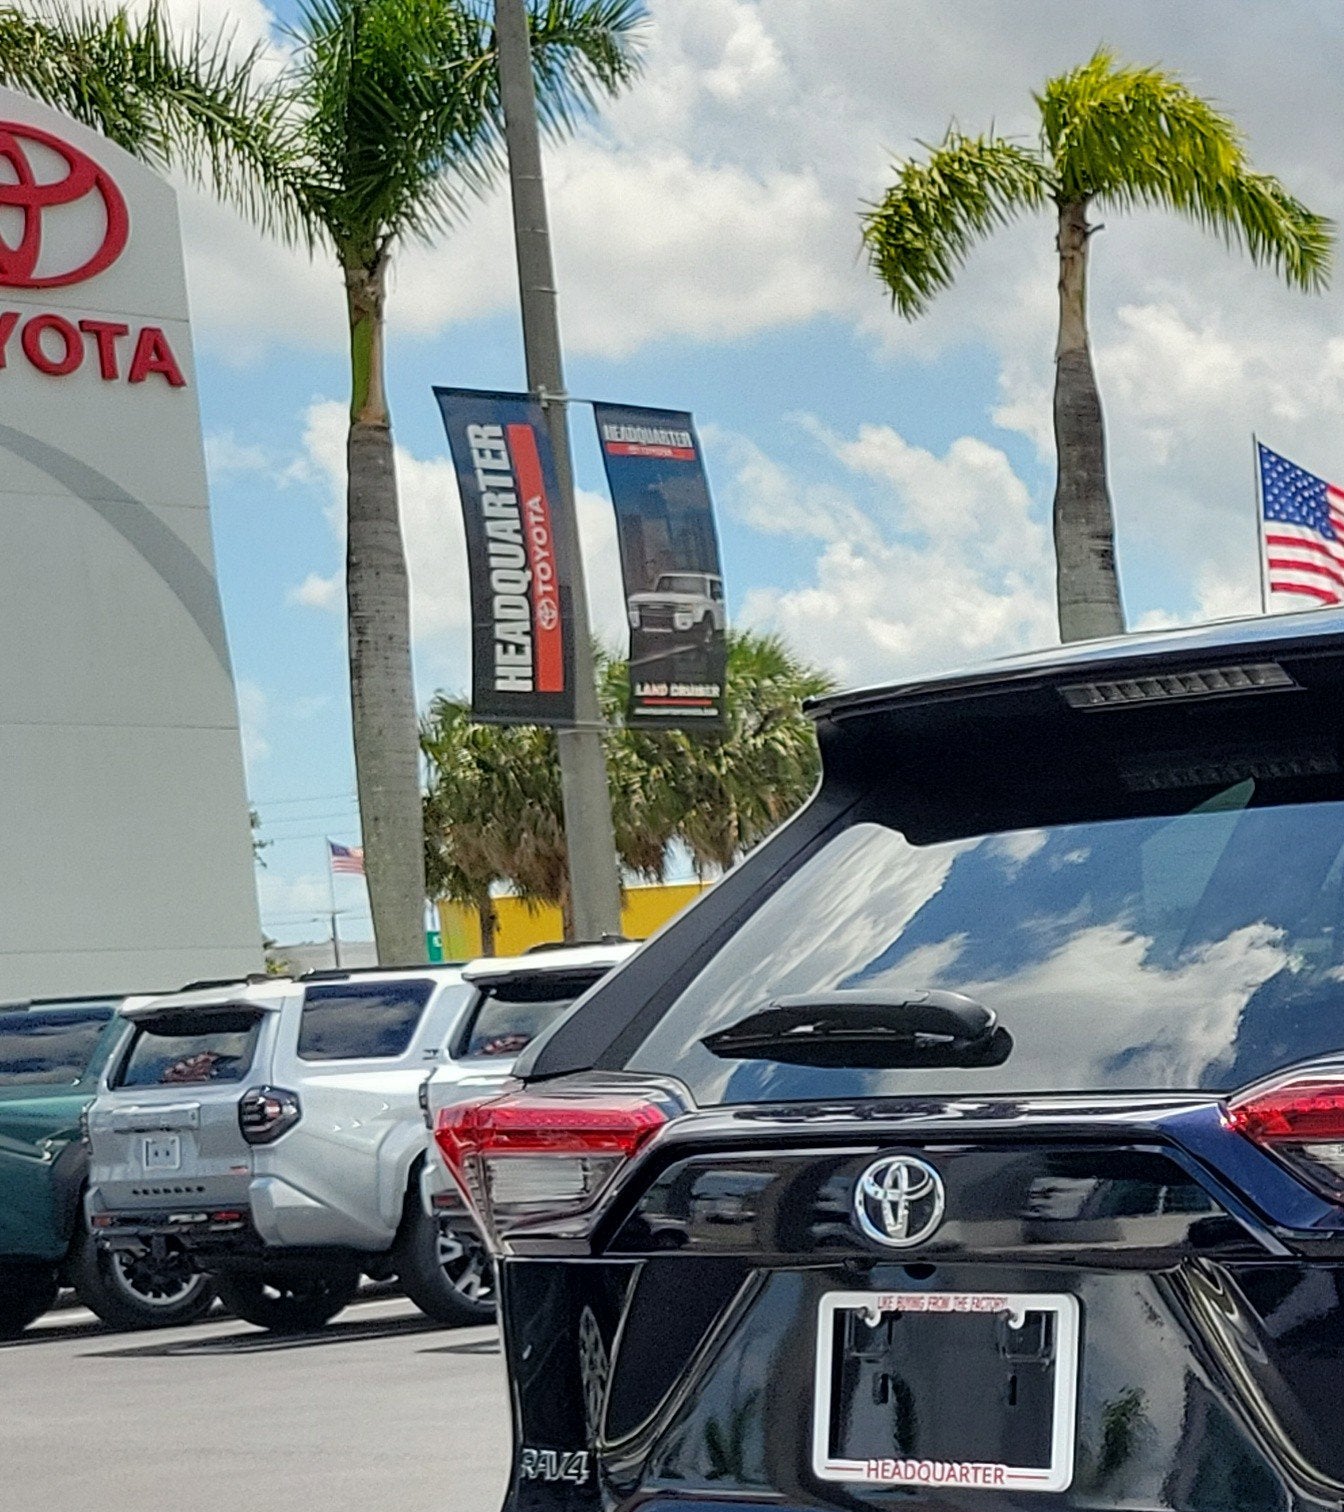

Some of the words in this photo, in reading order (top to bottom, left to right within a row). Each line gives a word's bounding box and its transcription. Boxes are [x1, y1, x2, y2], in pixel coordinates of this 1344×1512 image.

[467, 423, 534, 693] HEADQUARTER
[526, 495, 554, 595] TOYOTA
[520, 1448, 590, 1485] RAV4
[867, 1460, 1005, 1484] HEADQUARTER
